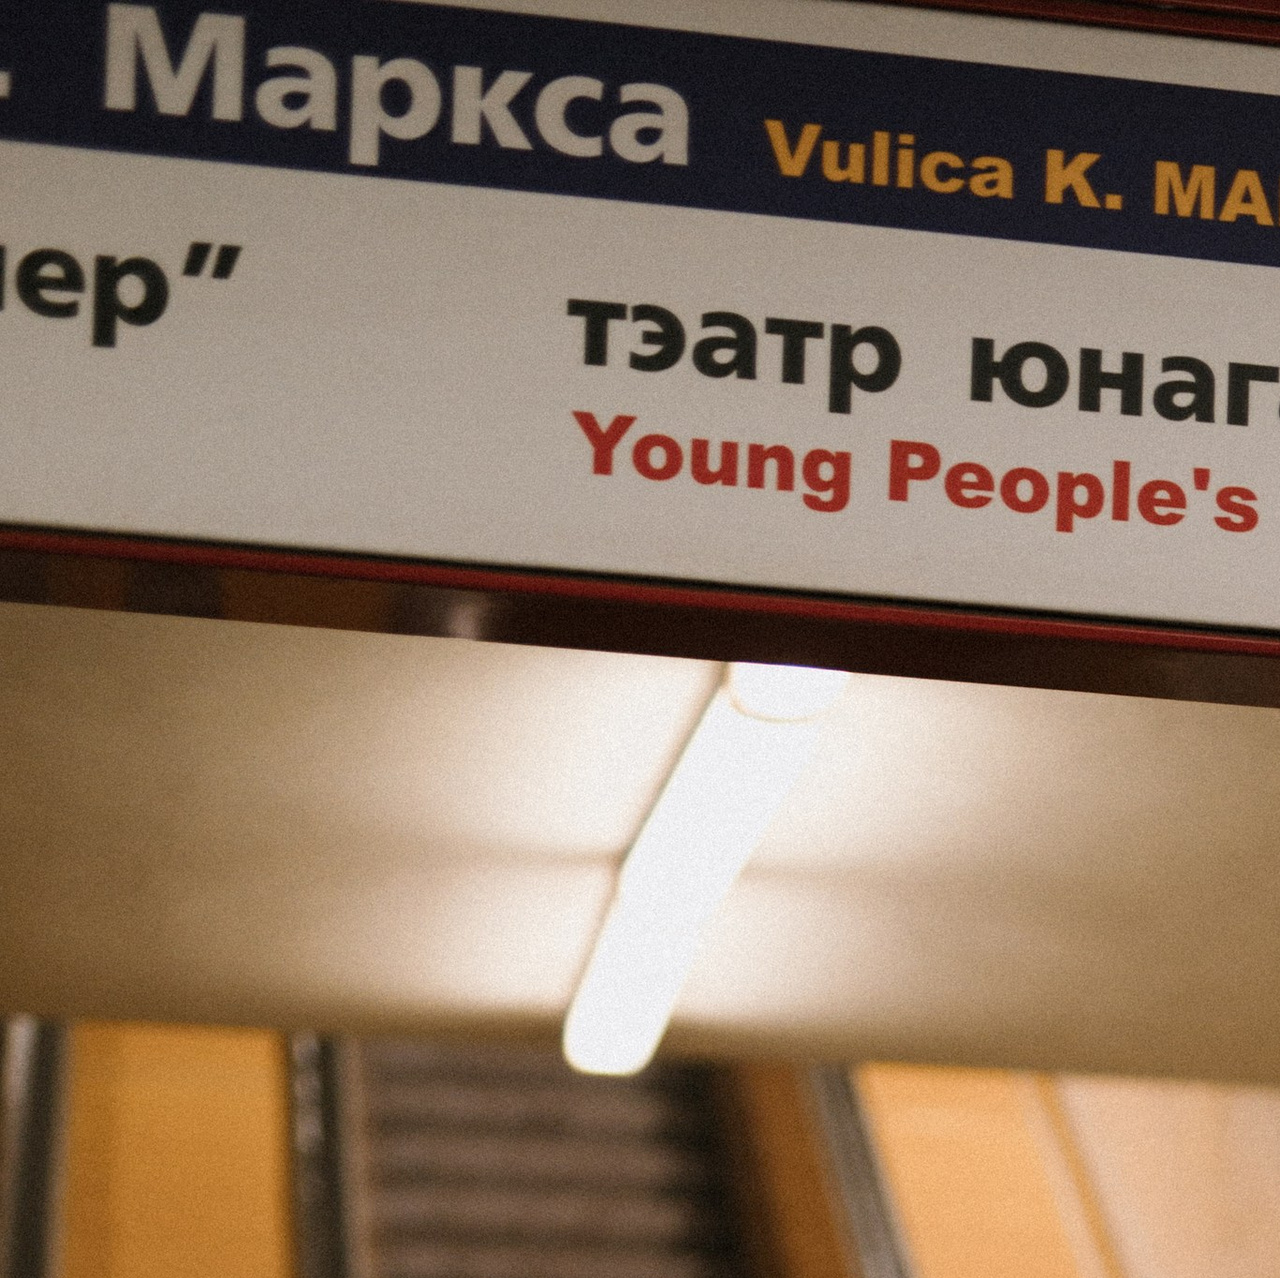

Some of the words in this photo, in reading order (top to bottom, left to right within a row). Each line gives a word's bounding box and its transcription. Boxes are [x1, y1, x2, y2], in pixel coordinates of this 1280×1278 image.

[104, 4, 690, 167] Маркса
[764, 118, 1016, 200] Vulica
[1044, 148, 1125, 211] K.
[0, 241, 242, 349] ер”
[567, 298, 903, 415] тэатр
[572, 410, 853, 514] Young
[887, 439, 1261, 535] People's
